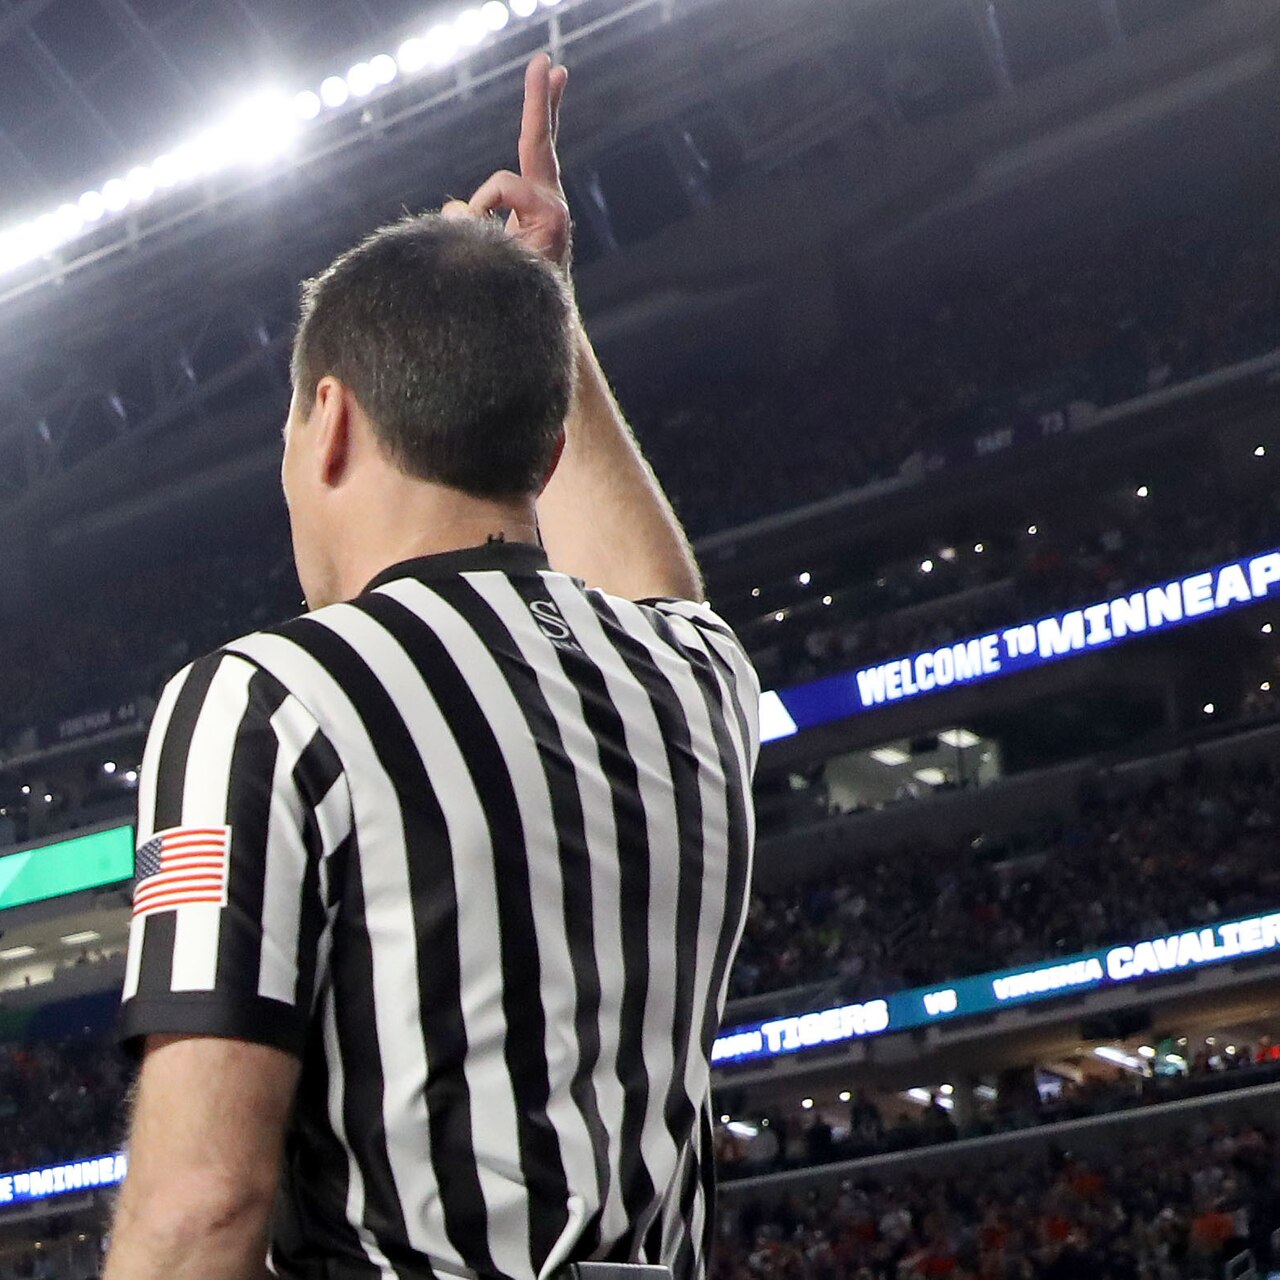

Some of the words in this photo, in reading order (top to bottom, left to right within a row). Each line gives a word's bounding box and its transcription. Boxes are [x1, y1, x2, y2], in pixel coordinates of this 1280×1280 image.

[856, 633, 1002, 707] WELCOME
[1003, 623, 1037, 659] TO
[1036, 552, 1280, 659] MINNEAP
[761, 999, 890, 1053] TIGERS
[923, 989, 957, 1014] VS
[994, 958, 1104, 999] VIRGINIA
[1106, 912, 1280, 981] CAVALIER
